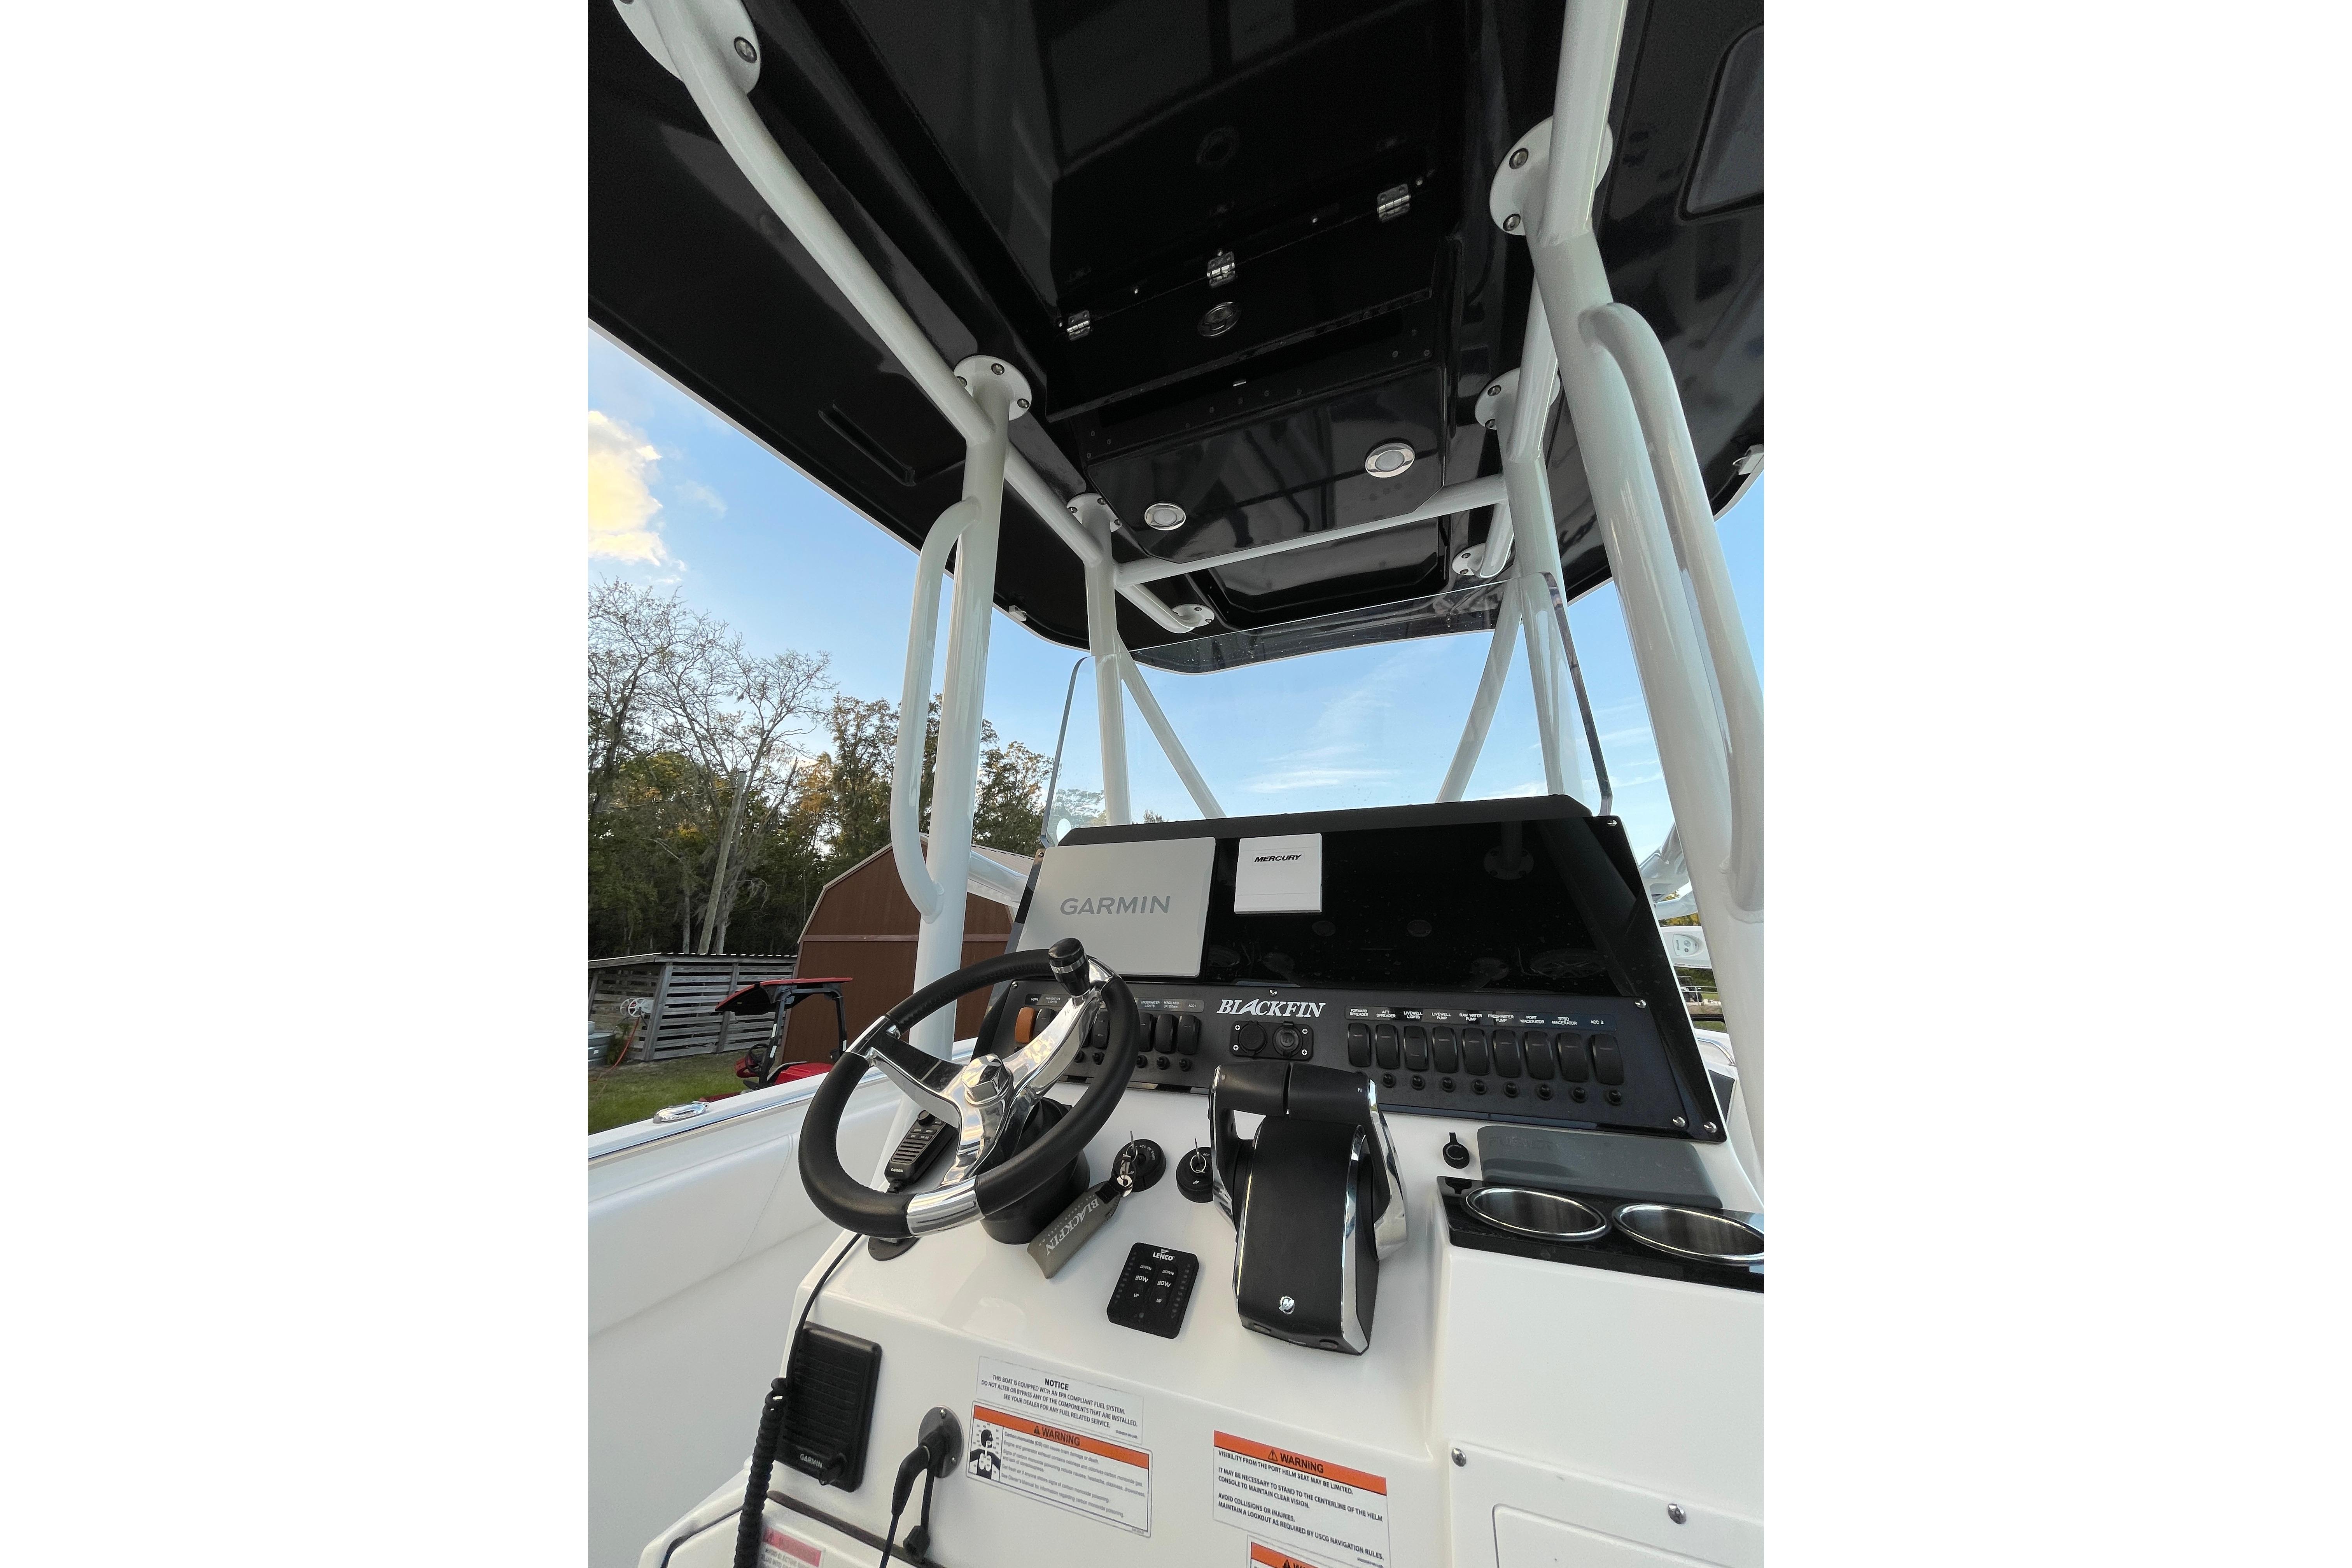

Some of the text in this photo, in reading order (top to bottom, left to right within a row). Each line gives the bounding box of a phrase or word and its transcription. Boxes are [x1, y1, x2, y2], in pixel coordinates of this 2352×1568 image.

[1060, 896, 1171, 915] GARMIN
[1216, 999, 1326, 1018] BLACKFIN
[1046, 1198, 1099, 1255] BLACKFIN
[1153, 1252, 1173, 1261] LENCO
[1018, 1381, 1038, 1391] EQUIPPED
[1040, 1386, 1050, 1395] WITH
[1068, 1394, 1093, 1406] COMPLIANT
[1106, 1404, 1125, 1414] SYSTEM.
[1045, 1378, 1069, 1391] NOTICE
[998, 1384, 1009, 1392] ALTER
[1017, 1389, 1032, 1398] BYPASS
[1058, 1400, 1089, 1414] COMPONENTS
[1090, 1409, 1101, 1417] THAT
[1112, 1414, 1137, 1426] INSTALLED.
[1012, 1396, 1022, 1404] YOUR
[1024, 1399, 1039, 1409] DEALER
[1059, 1409, 1070, 1417] FUEL
[1071, 1412, 1090, 1423] RELATED
[1091, 1418, 1110, 1428] SERVICE.
[1042, 1427, 1080, 1446] WARNING
[800, 1454, 822, 1468] GARMIN
[1218, 1450, 1242, 1461] VISIBILITY
[1243, 1458, 1257, 1467] FROM
[1283, 1469, 1296, 1477] HELM
[1298, 1473, 1309, 1482] SEAT
[1331, 1482, 1353, 1495] LIMITED.
[1280, 1452, 1324, 1473] WARNING
[1219, 1475, 1241, 1487] CONSOLE
[1249, 1485, 1272, 1496] MAINTAIN
[1274, 1493, 1290, 1502] CLEAR
[1291, 1497, 1310, 1508] VISION.
[1242, 1474, 1269, 1487] NECESSARY
[1279, 1485, 1295, 1494] STAND
[1315, 1496, 1346, 1510] CENTERLINE
[1356, 1508, 1366, 1517] THE
[1218, 1493, 1233, 1502] AVOID
[1234, 1498, 1262, 1511] COLLISIONS
[1272, 1510, 1295, 1522] INJURIES.
[1218, 1501, 1242, 1514] MAINTAIN
[1248, 1510, 1271, 1523] LOOKOUT
[1280, 1521, 1306, 1534] REQUIRED
[1330, 1537, 1363, 1554] NAVIGATION
